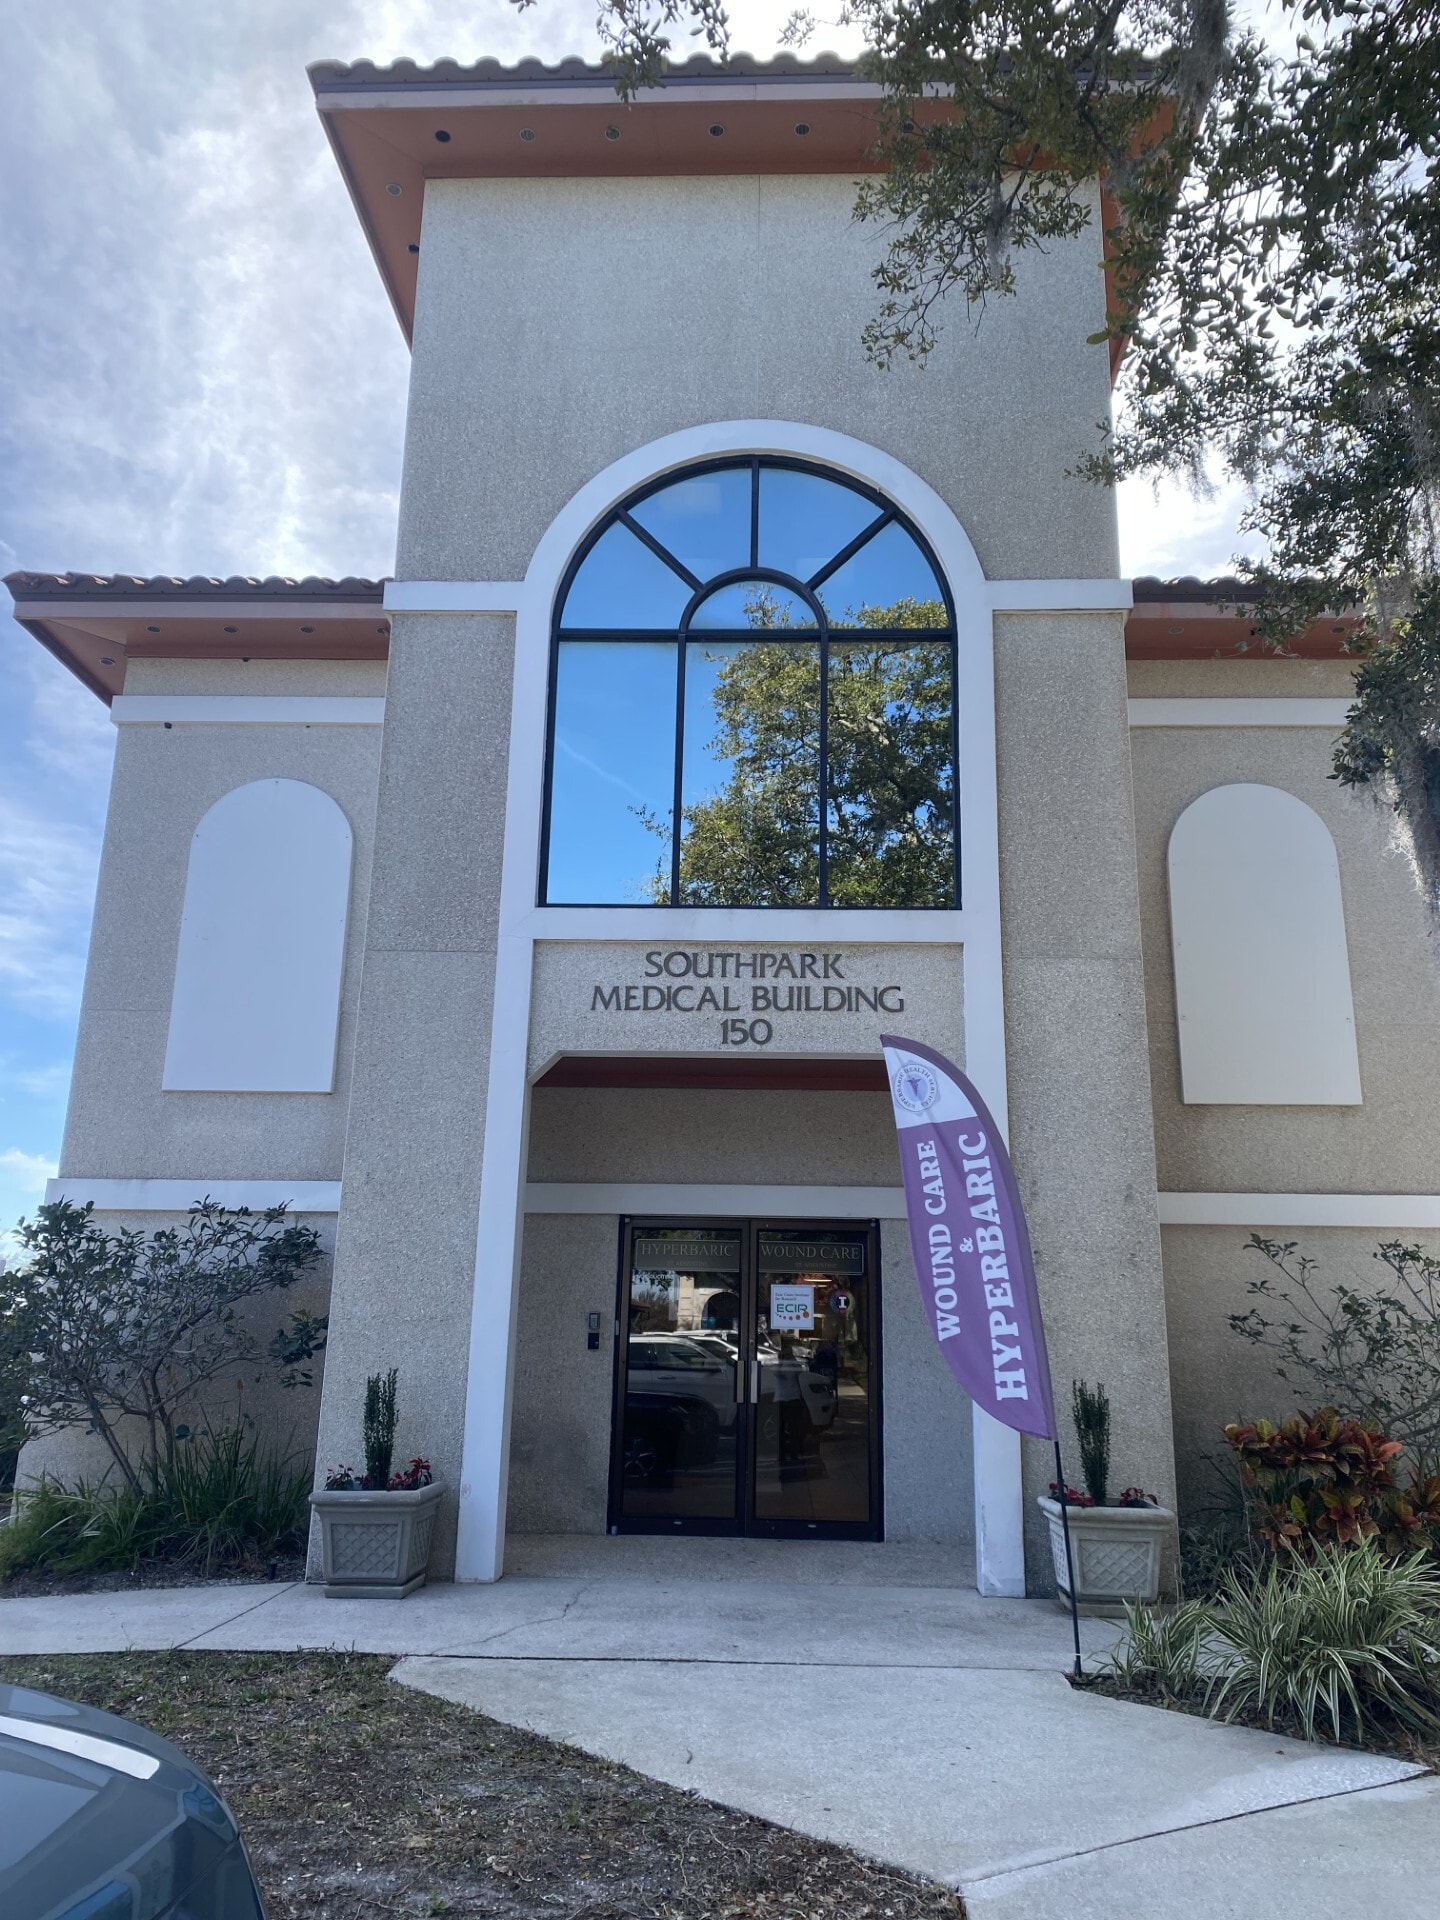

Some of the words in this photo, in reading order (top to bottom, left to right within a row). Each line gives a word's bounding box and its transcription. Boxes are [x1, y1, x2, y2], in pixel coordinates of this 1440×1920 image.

[644, 951, 845, 979] SOUTHPARK
[590, 985, 741, 1012] MEDICAL
[751, 986, 905, 1013] BUILDING
[720, 1018, 773, 1045] 150
[917, 1140, 948, 1216] CARE
[641, 1243, 735, 1257] HYPERBARIC
[761, 1245, 817, 1258] WOUND
[820, 1247, 860, 1260] CARE
[959, 1236, 974, 1254] &
[958, 1131, 1029, 1401] HYPERBARIC
[928, 1223, 961, 1341] WOUND
[776, 1303, 808, 1313] ECIR
